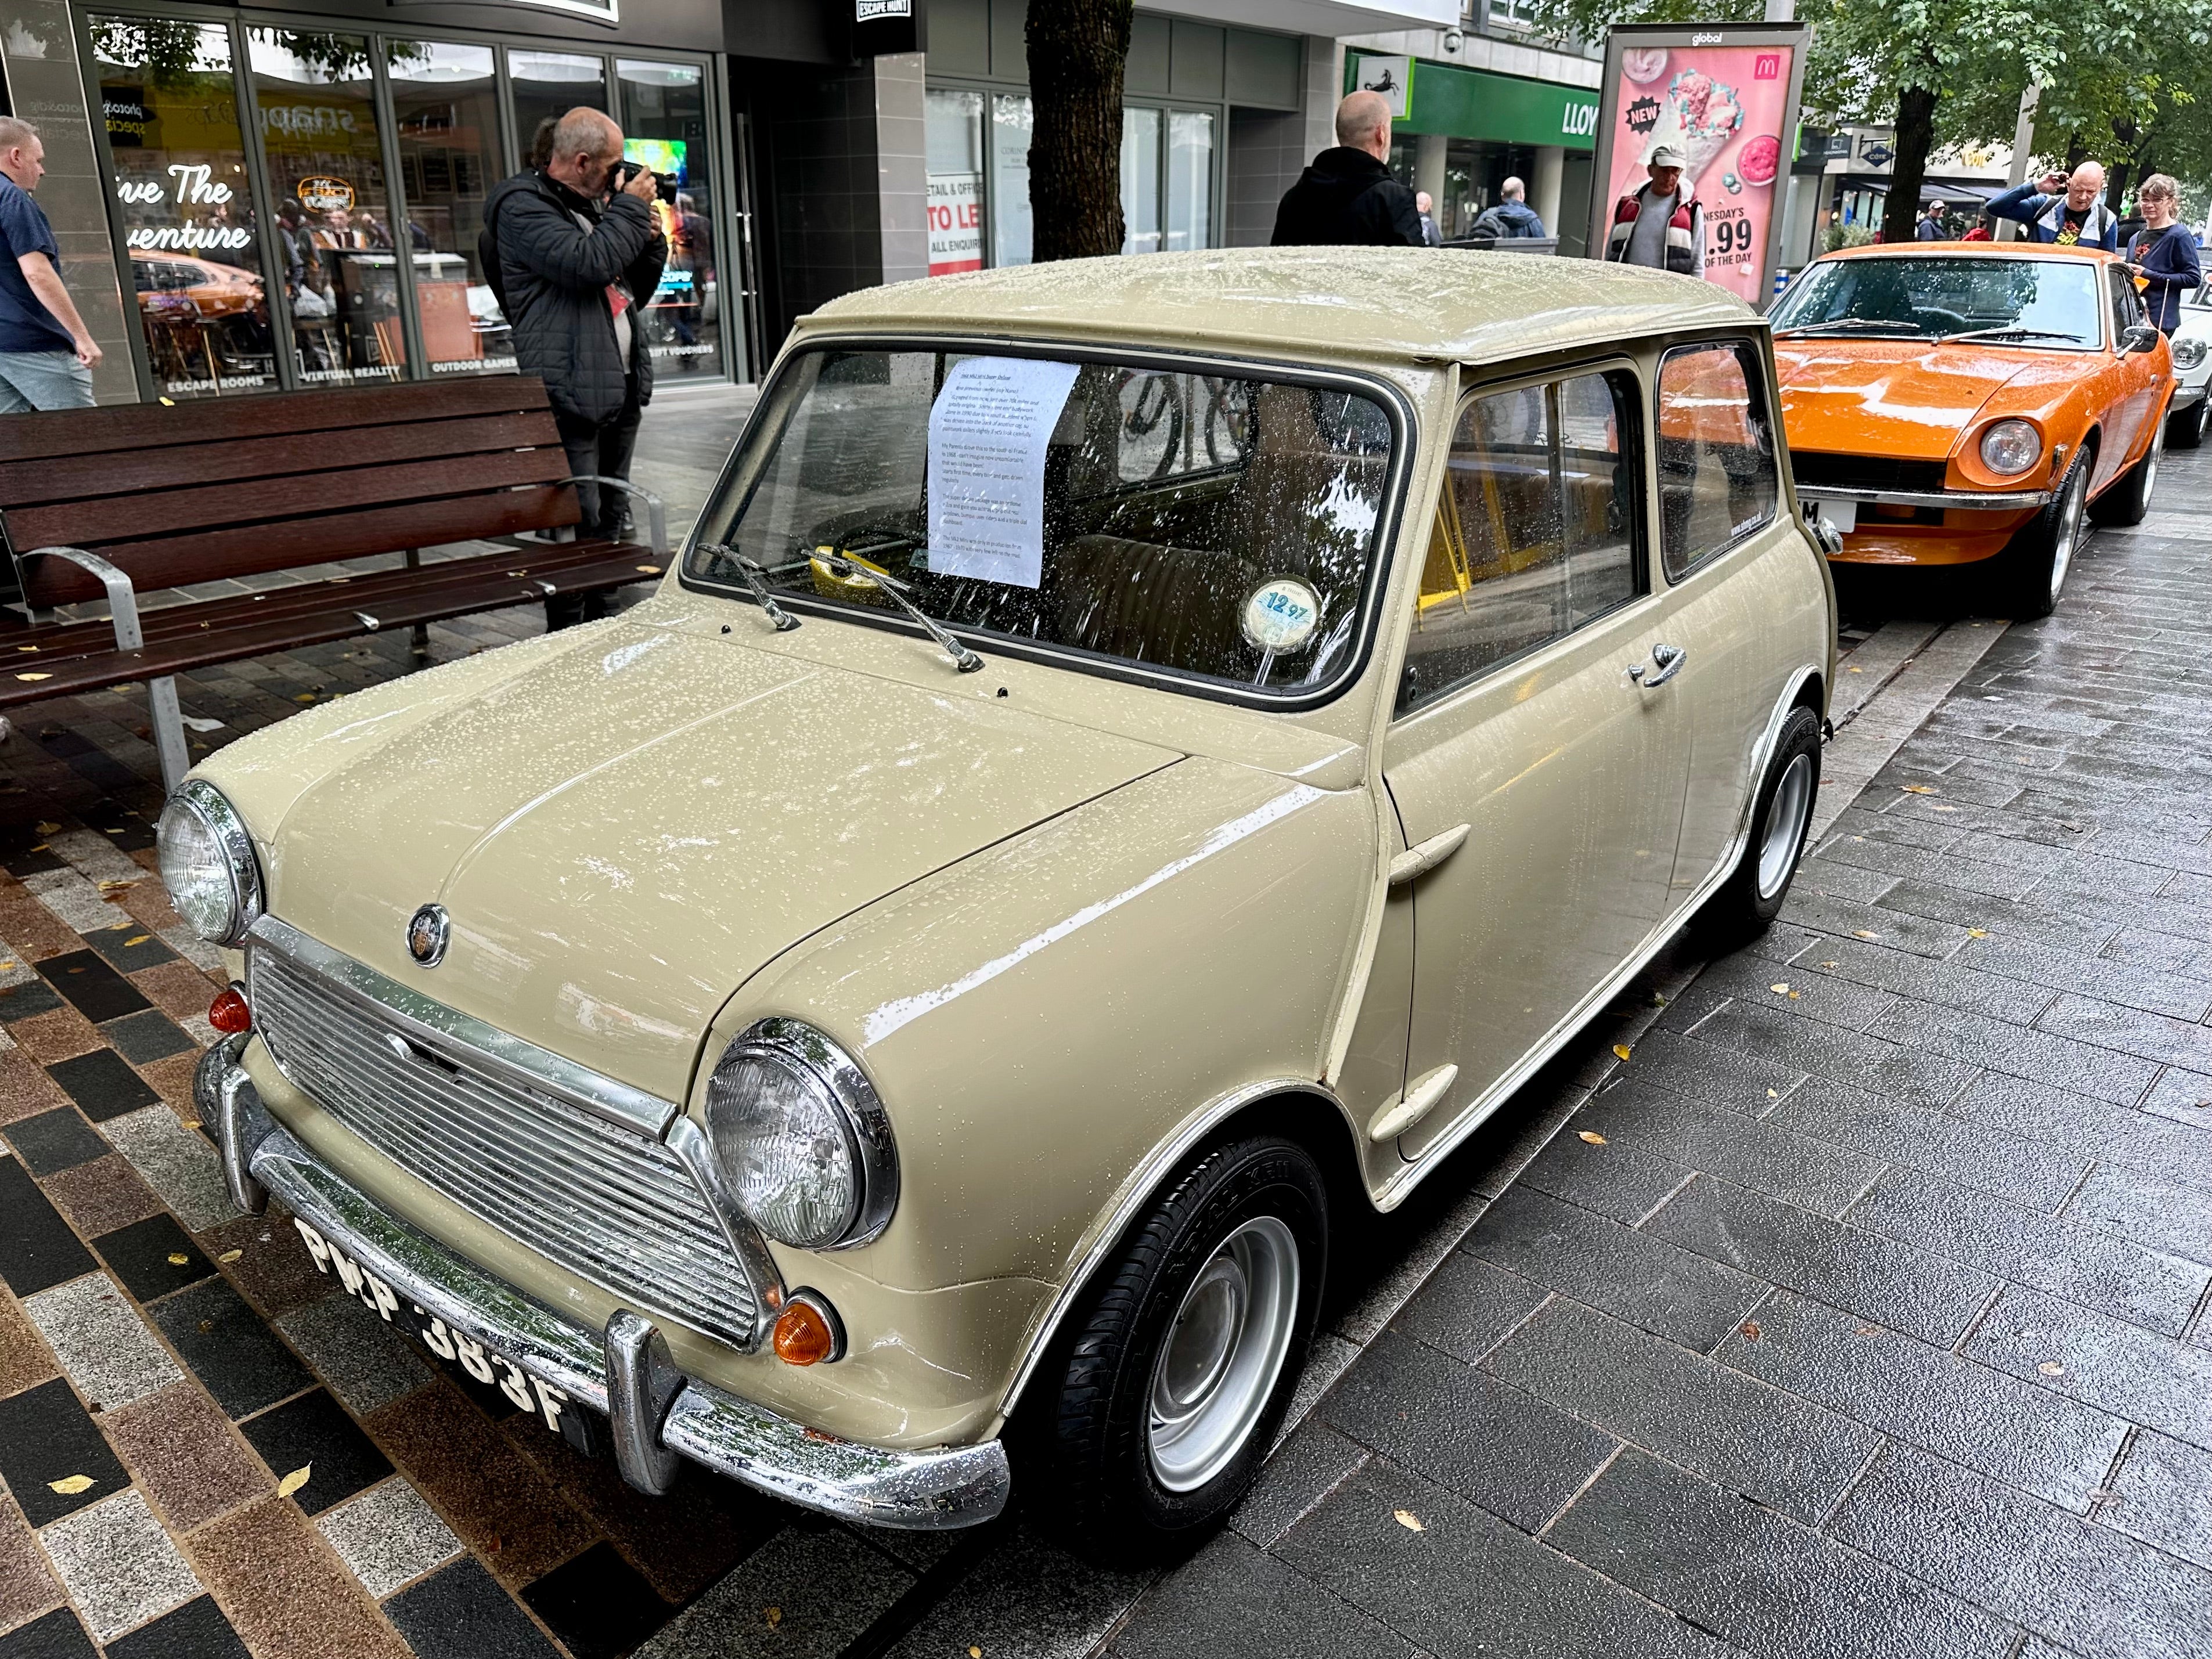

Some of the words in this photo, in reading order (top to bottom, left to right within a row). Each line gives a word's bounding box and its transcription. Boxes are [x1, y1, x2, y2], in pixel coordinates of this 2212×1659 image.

[859, 2, 887, 17] ESCAPE
[887, 0, 907, 12] HUNT
[1692, 32, 1723, 46] global
[1562, 102, 1599, 136] LLOY
[1630, 105, 1657, 125] NEW
[116, 176, 165, 204] ve
[168, 164, 233, 204] The
[950, 183, 956, 195] &
[927, 205, 952, 232] TO
[957, 204, 983, 229] LE
[1704, 207, 1744, 222] NESDAY'S
[1704, 219, 1752, 256] .99
[931, 241, 947, 254] ALL
[1705, 256, 1717, 268] OF
[1717, 255, 1733, 266] THE
[1735, 253, 1752, 264] DAY
[668, 345, 714, 356] VOUCHERS
[432, 360, 482, 373] OUTDOOR
[483, 356, 517, 369] GAMES
[304, 368, 353, 382] VIRTUAL
[354, 366, 399, 378] REALITY
[167, 380, 217, 392] ESCAPE
[219, 375, 265, 389] ROOMS
[1267, 592, 1288, 614] 12
[1288, 604, 1308, 620] 97
[413, 1304, 569, 1433] 383F
